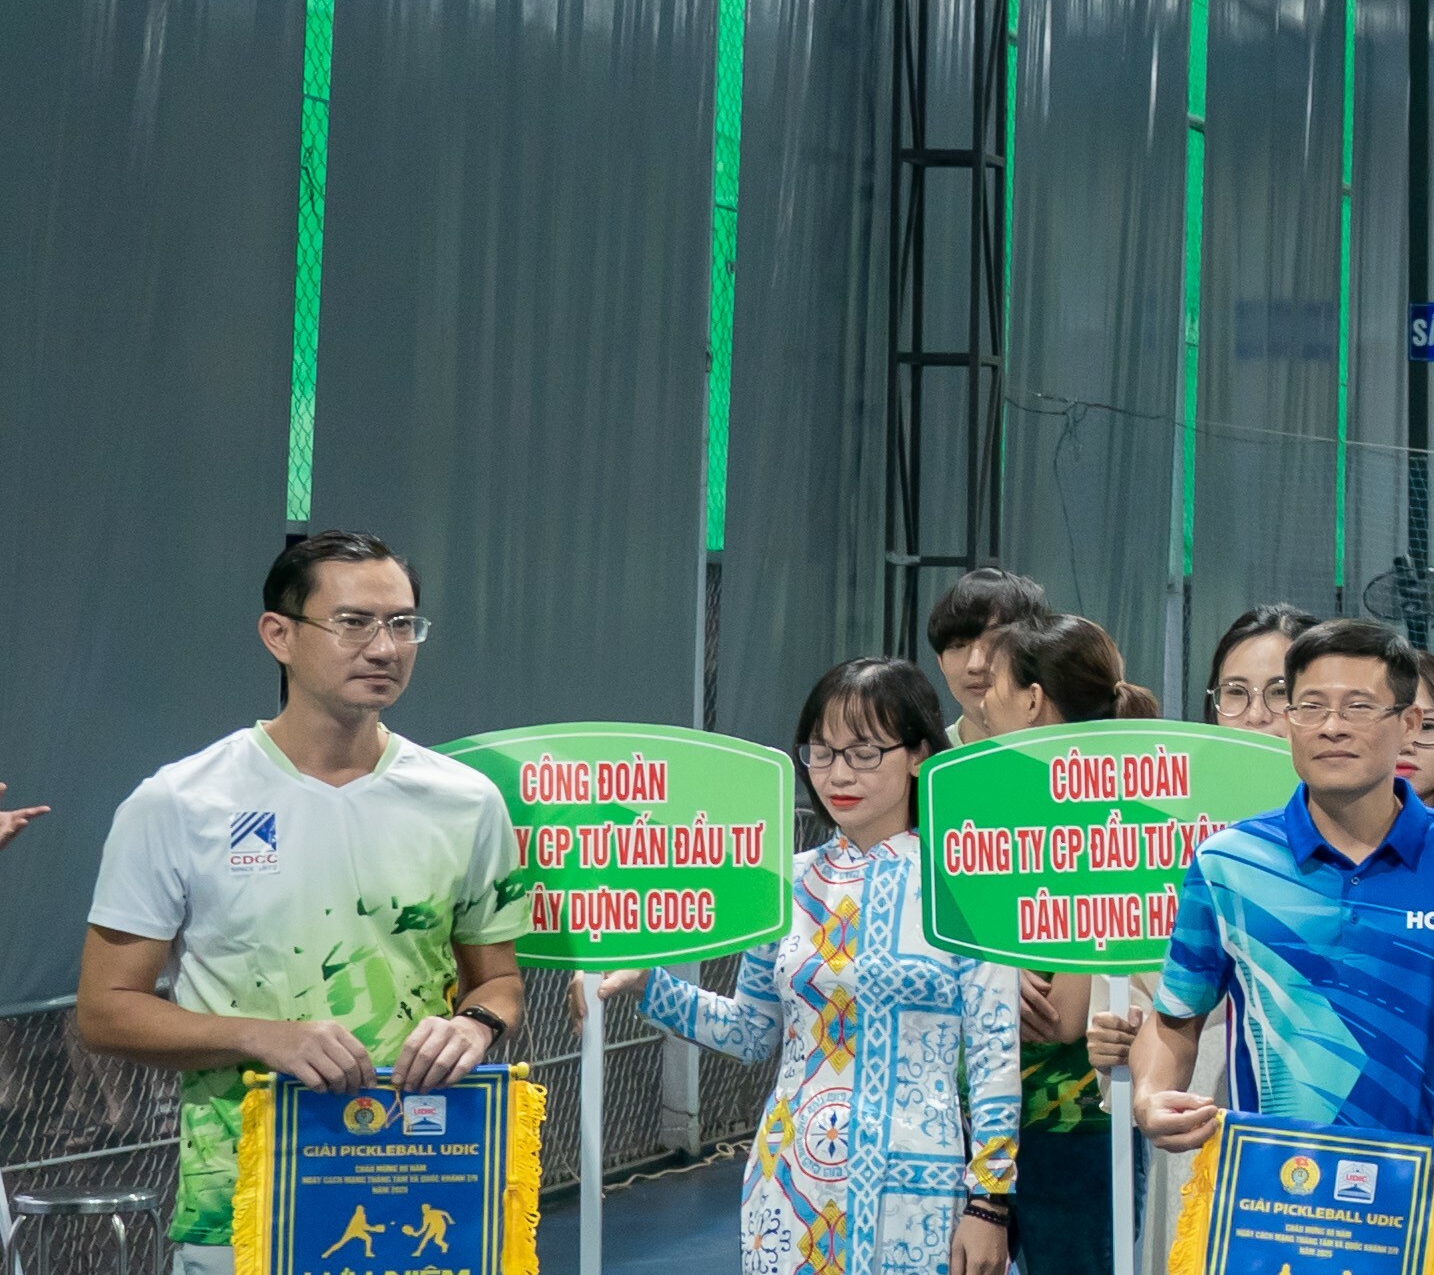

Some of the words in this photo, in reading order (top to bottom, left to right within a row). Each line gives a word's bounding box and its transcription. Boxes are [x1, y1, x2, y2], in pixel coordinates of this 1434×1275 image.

[522, 755, 590, 802] CÔNG
[597, 752, 666, 801] ĐOÀN
[1051, 748, 1116, 801] CÔNG
[1123, 745, 1189, 798] ĐOÀN
[231, 854, 278, 865] CDCC
[538, 828, 571, 866] CP
[578, 823, 612, 866] TƯ
[616, 813, 667, 865] VẤN
[673, 813, 724, 865] ĐẦU
[731, 822, 765, 865] TƯ
[945, 821, 1011, 874] CÔNG
[1016, 828, 1044, 872] TY
[1051, 826, 1083, 870] CP
[1088, 811, 1138, 869] ĐẦU
[1144, 820, 1176, 868] TƯ
[527, 884, 562, 931] ÂY
[570, 887, 638, 941] DỰNG
[646, 891, 714, 930] CDCC
[1019, 889, 1069, 942] DÂN
[1076, 896, 1141, 949] DỤNG
[1148, 885, 1178, 938] HÀ
[303, 1143, 336, 1157] GIẢI
[340, 1145, 437, 1157] PICKLEBALL
[440, 1143, 479, 1156] UDIC
[1239, 1198, 1270, 1213] GIẢI
[1273, 1202, 1362, 1224] PICKLEBALL
[1366, 1213, 1403, 1228] UDIC
